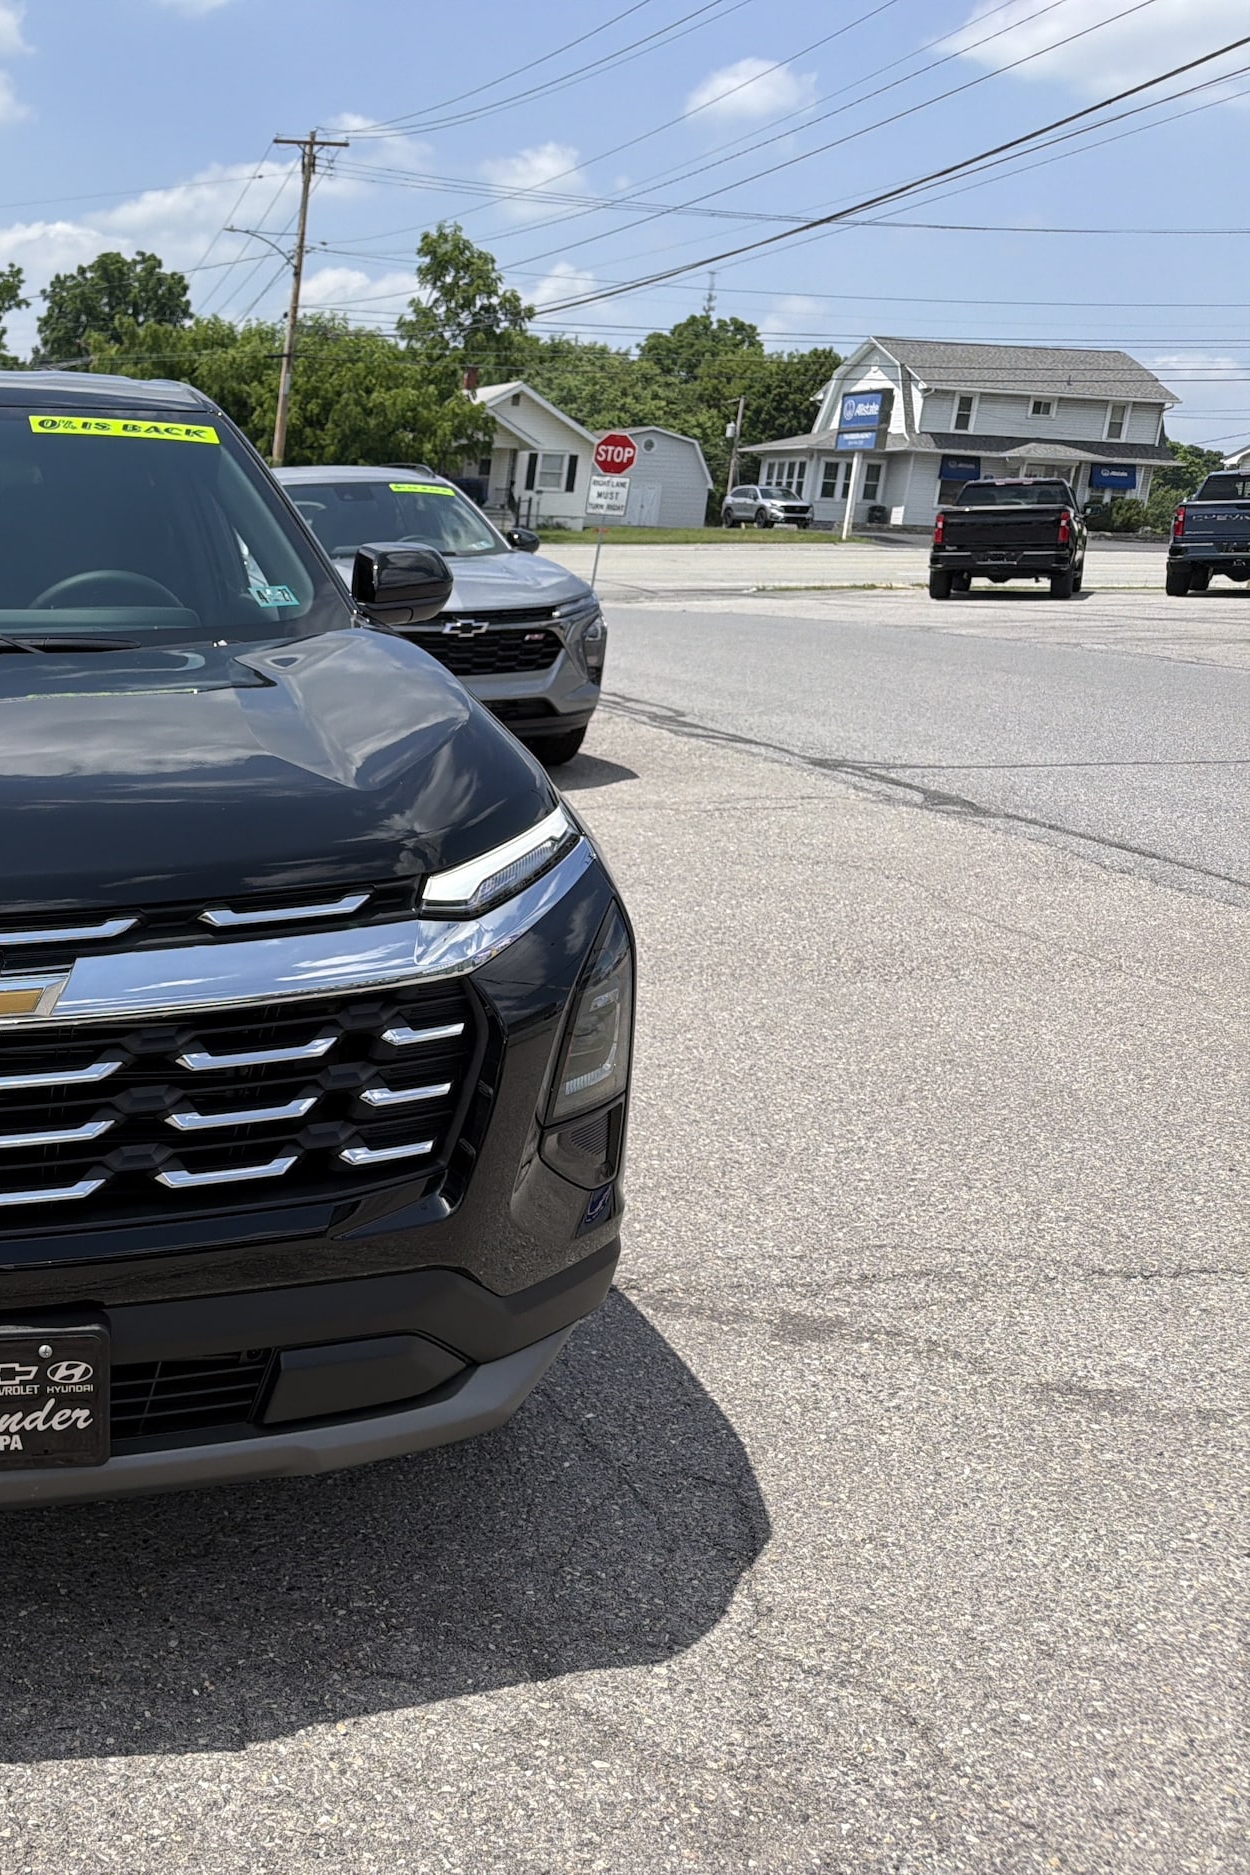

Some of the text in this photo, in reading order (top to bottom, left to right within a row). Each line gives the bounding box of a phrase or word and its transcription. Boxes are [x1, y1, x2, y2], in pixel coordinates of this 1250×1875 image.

[854, 401, 879, 416] Allstate
[38, 418, 207, 438] 0% IS BACK
[596, 444, 634, 463] STOP
[612, 481, 627, 489] LANE
[597, 491, 620, 500] MUST
[606, 503, 624, 511] RIGHT
[47, 1384, 93, 1393] HYUNDAI
[0, 1435, 23, 1451] PA
